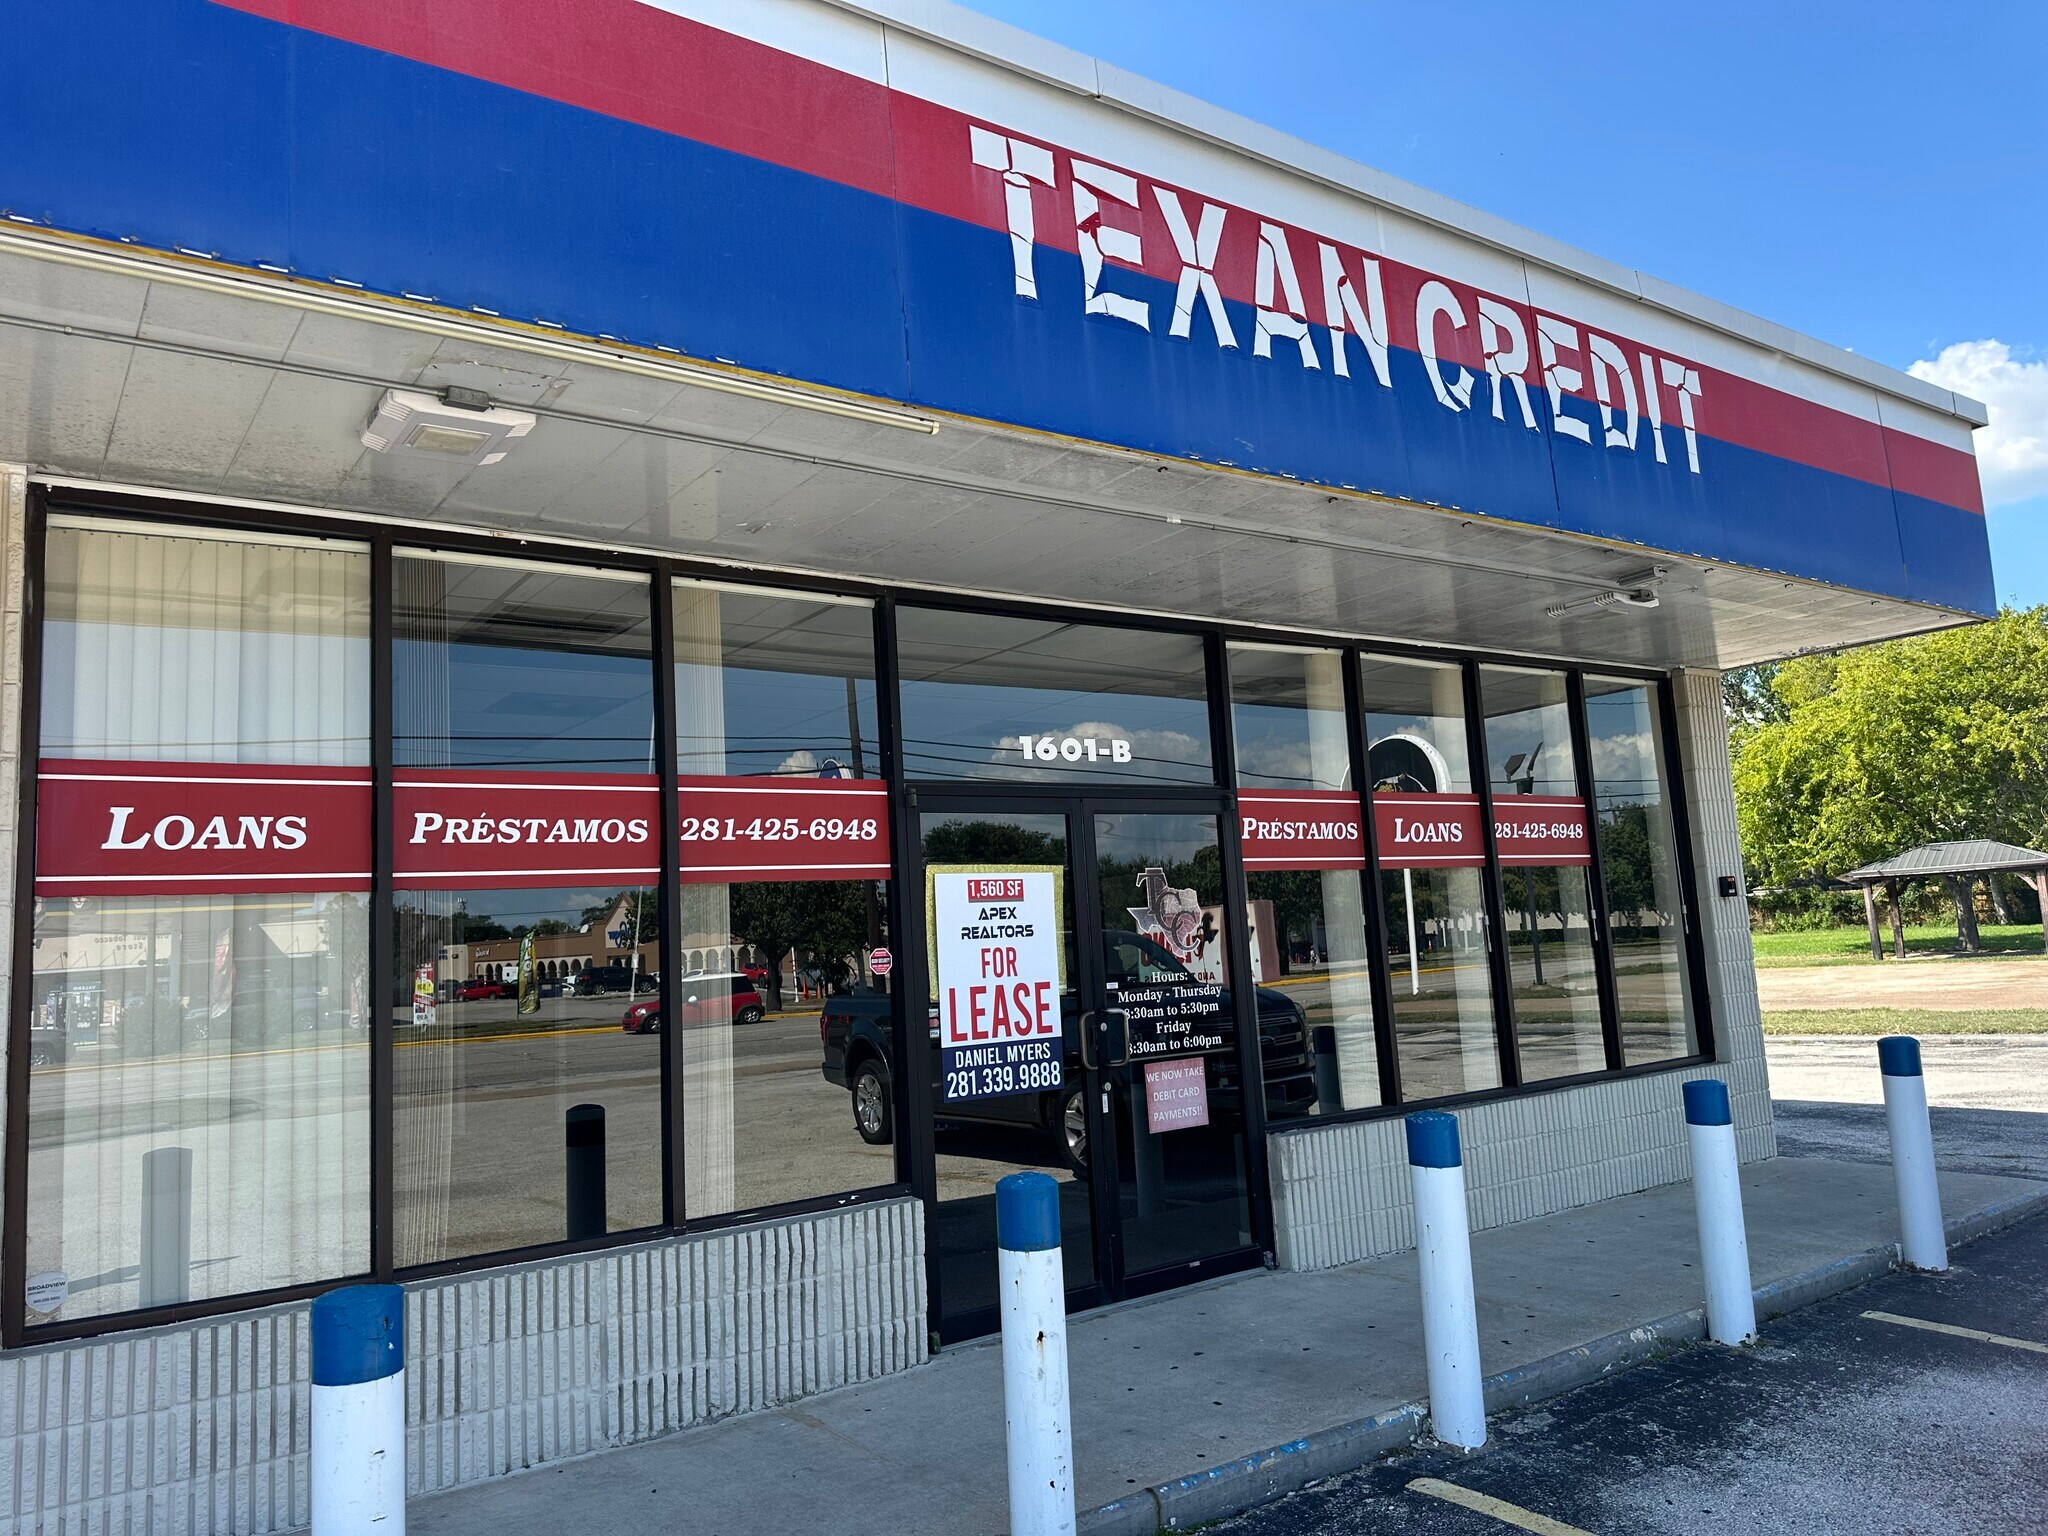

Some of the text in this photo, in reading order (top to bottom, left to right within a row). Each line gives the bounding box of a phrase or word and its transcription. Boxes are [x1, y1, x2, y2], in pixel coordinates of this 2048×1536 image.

[969, 124, 1703, 475] TEXAN CREDIT
[1018, 735, 1132, 763] 1601-B
[680, 817, 877, 841] 281-425-6948
[1494, 822, 1584, 840] 281-425-6948
[969, 880, 1022, 899] 1,560 SF
[978, 907, 1018, 921] APEX
[961, 924, 1034, 940] REALTORS
[980, 946, 1018, 979] FOR
[1152, 971, 1188, 982] Hours:
[1118, 989, 1163, 1003] Monday
[1172, 985, 1222, 1001] Thursday
[948, 981, 1053, 1043] LEASE
[1167, 1005, 1178, 1015] to
[1180, 1002, 1219, 1015] 5:30pm
[1156, 1022, 1191, 1034] Friday
[1170, 1039, 1181, 1049] to
[1183, 1035, 1222, 1049] 6:00pm
[955, 1042, 1051, 1069] DANIEL MYERS
[947, 1060, 1061, 1099] 281.339.9888
[1146, 1066, 1204, 1082] WE NOW TAKE
[1153, 1087, 1200, 1101] DEBIT CARD
[1153, 1105, 1203, 1122] PAYMENTS!!
[28, 1282, 66, 1291] BROADVIEW
